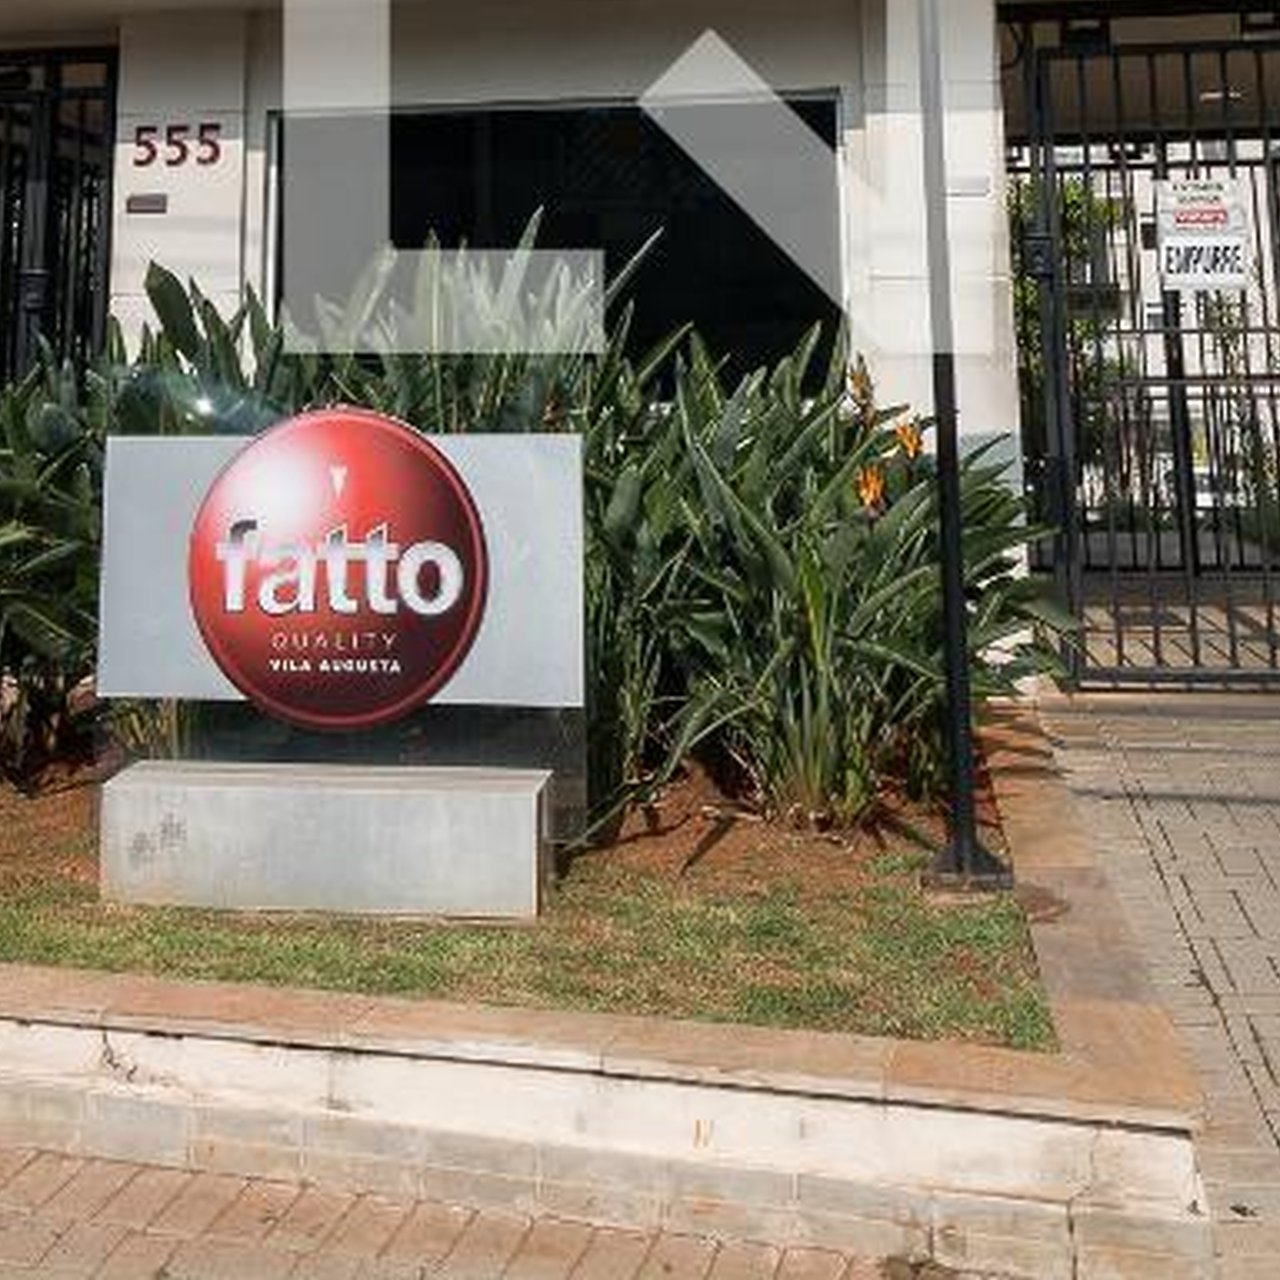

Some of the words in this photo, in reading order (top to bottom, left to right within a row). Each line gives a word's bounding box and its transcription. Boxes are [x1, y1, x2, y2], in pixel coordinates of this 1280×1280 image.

[133, 123, 221, 167] 555
[216, 519, 464, 615] fatto
[271, 630, 398, 651] QUALITY
[269, 659, 311, 672] VILA
[319, 659, 402, 673] AUGUSTA
